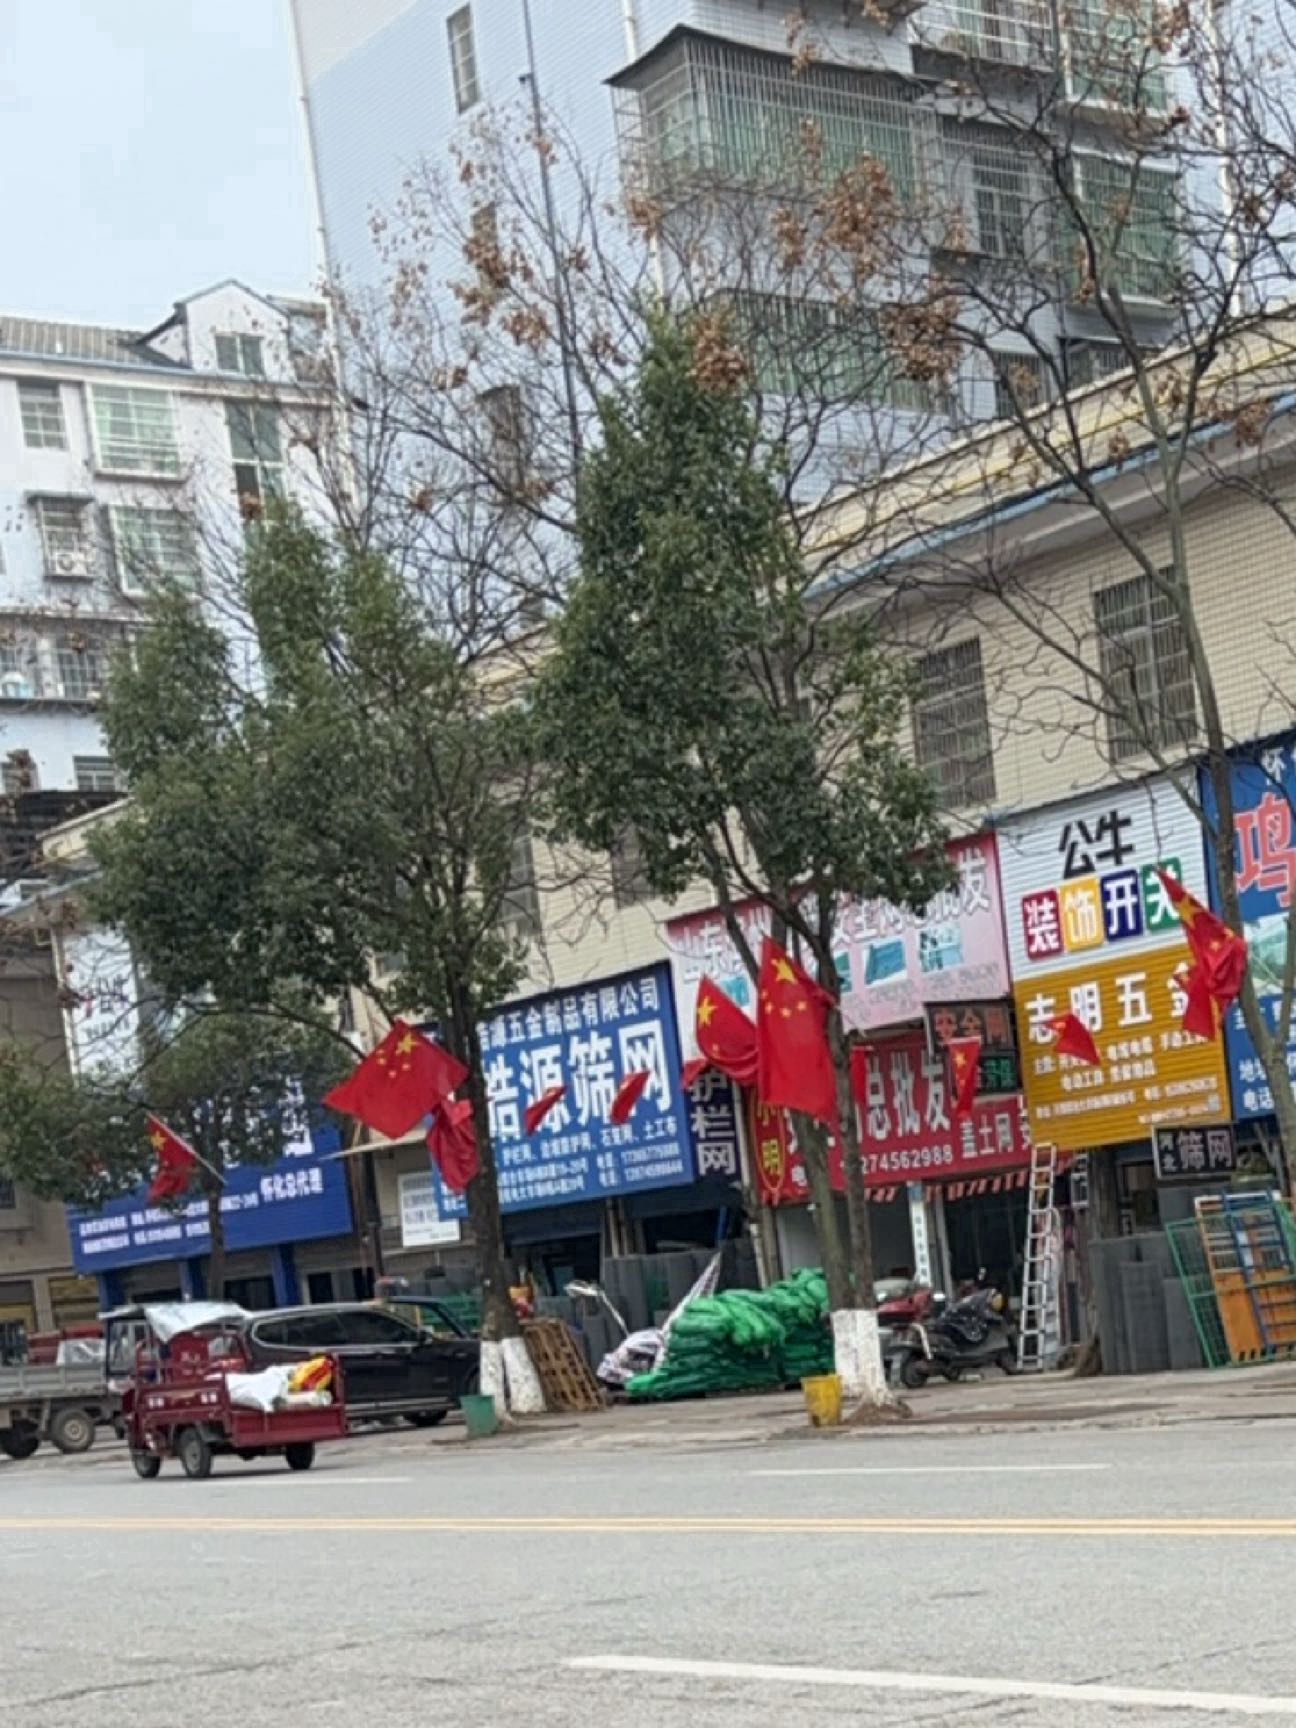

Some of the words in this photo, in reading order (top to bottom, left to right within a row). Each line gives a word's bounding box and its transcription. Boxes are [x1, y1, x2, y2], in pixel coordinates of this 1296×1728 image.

[1058, 811, 1134, 879] 公牛
[1024, 864, 1181, 954] 装饰开关
[690, 1068, 737, 1176] 护栏网
